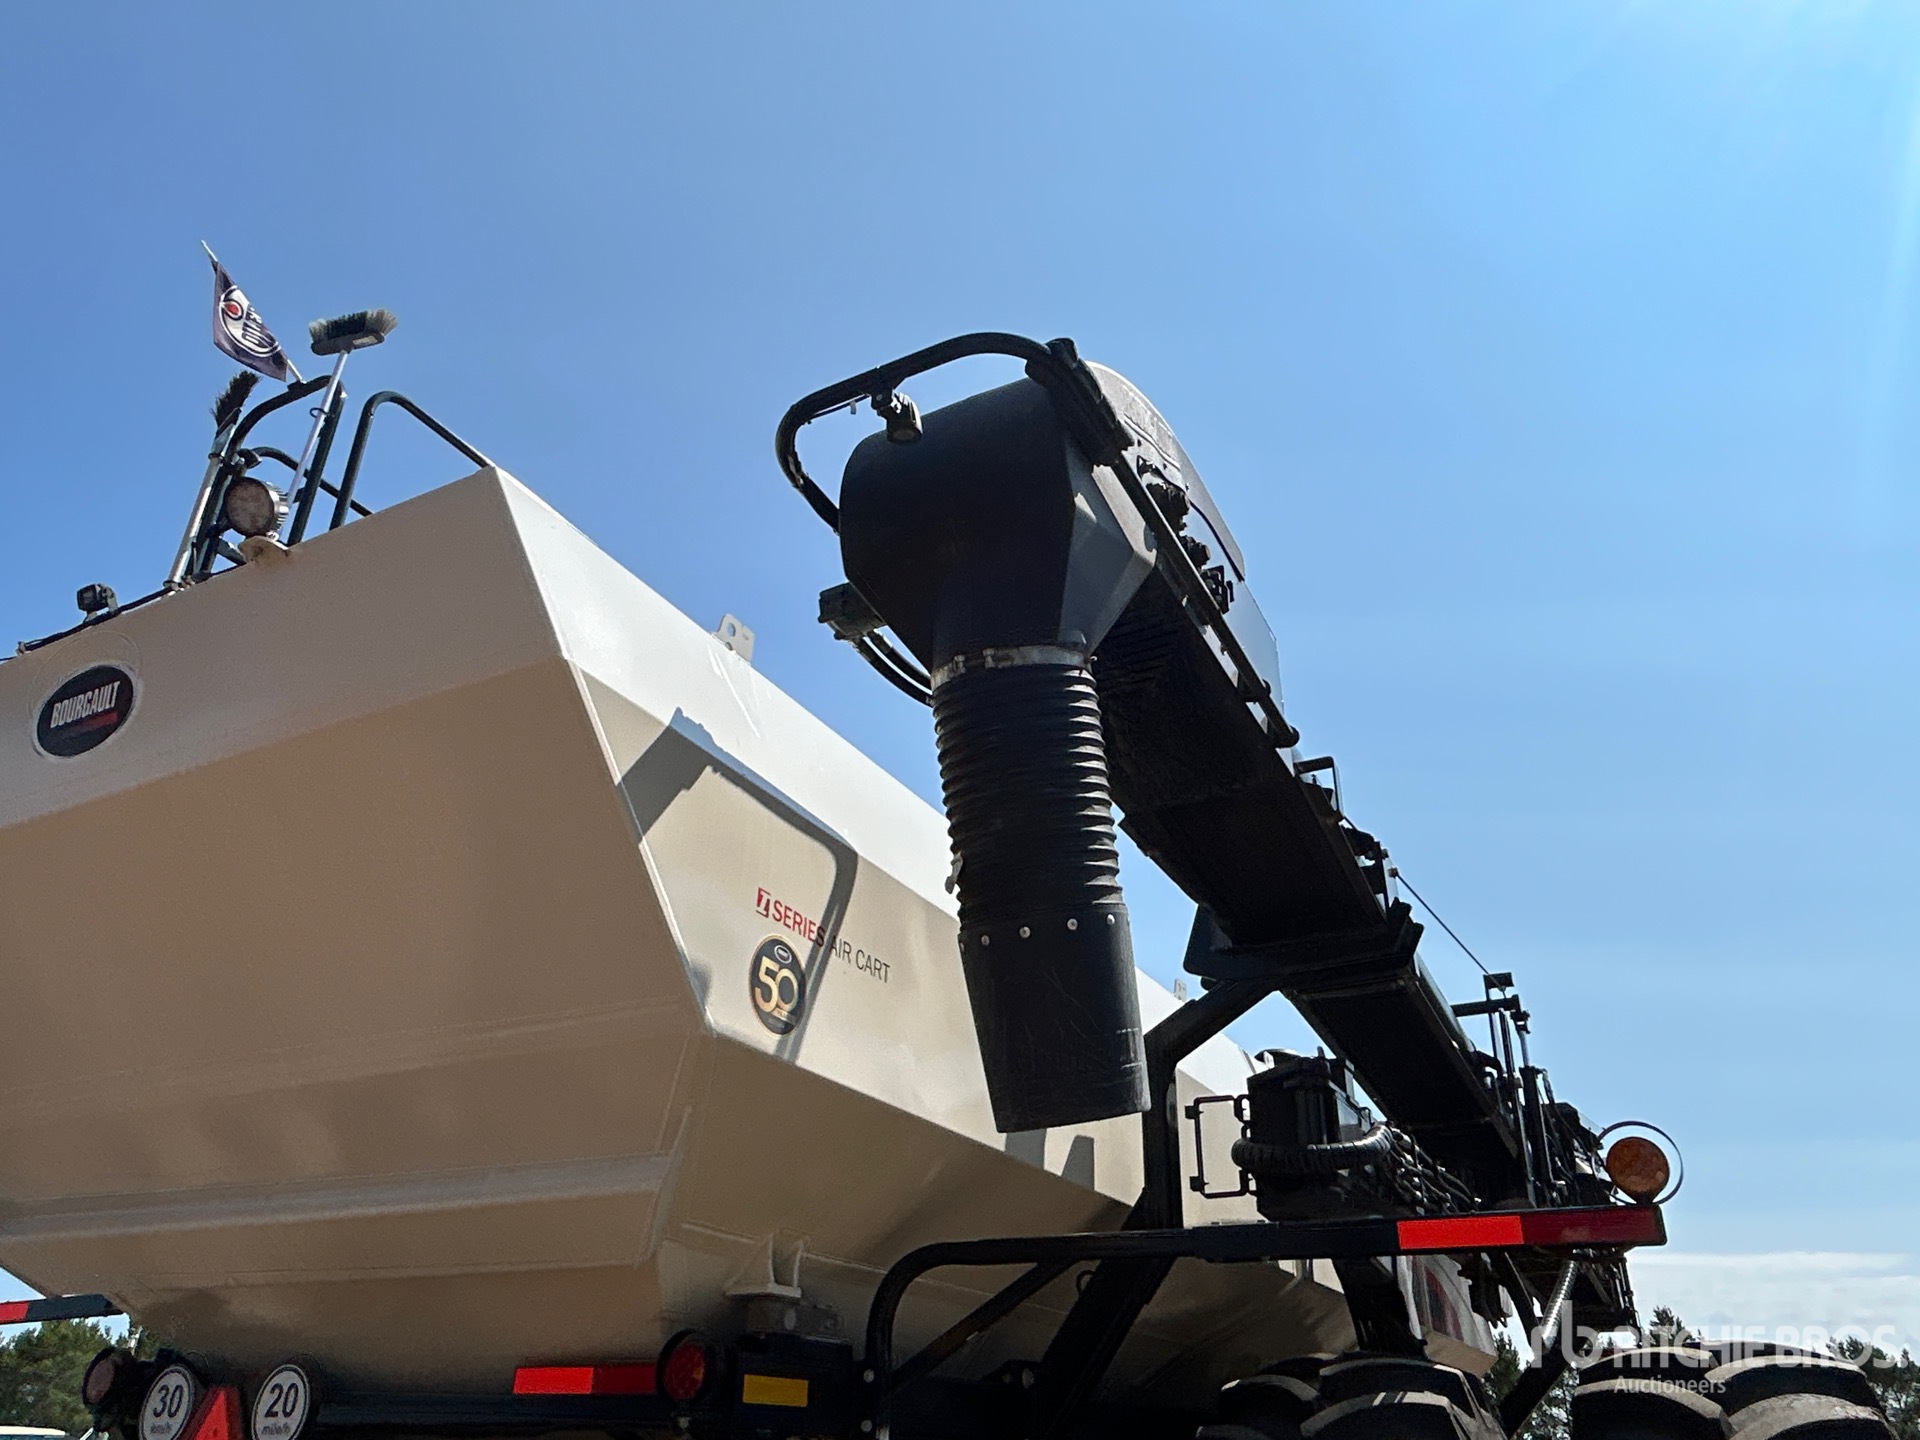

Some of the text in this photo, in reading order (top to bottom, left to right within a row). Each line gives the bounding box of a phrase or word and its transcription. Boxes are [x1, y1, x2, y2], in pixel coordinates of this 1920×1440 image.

[51, 682, 121, 728] BOURGAULT
[772, 900, 826, 946] SERIES
[829, 935, 852, 964] AIR
[855, 950, 890, 983] CART
[756, 955, 798, 1011] 50
[153, 1384, 183, 1417] 30
[264, 1383, 298, 1417] 20
